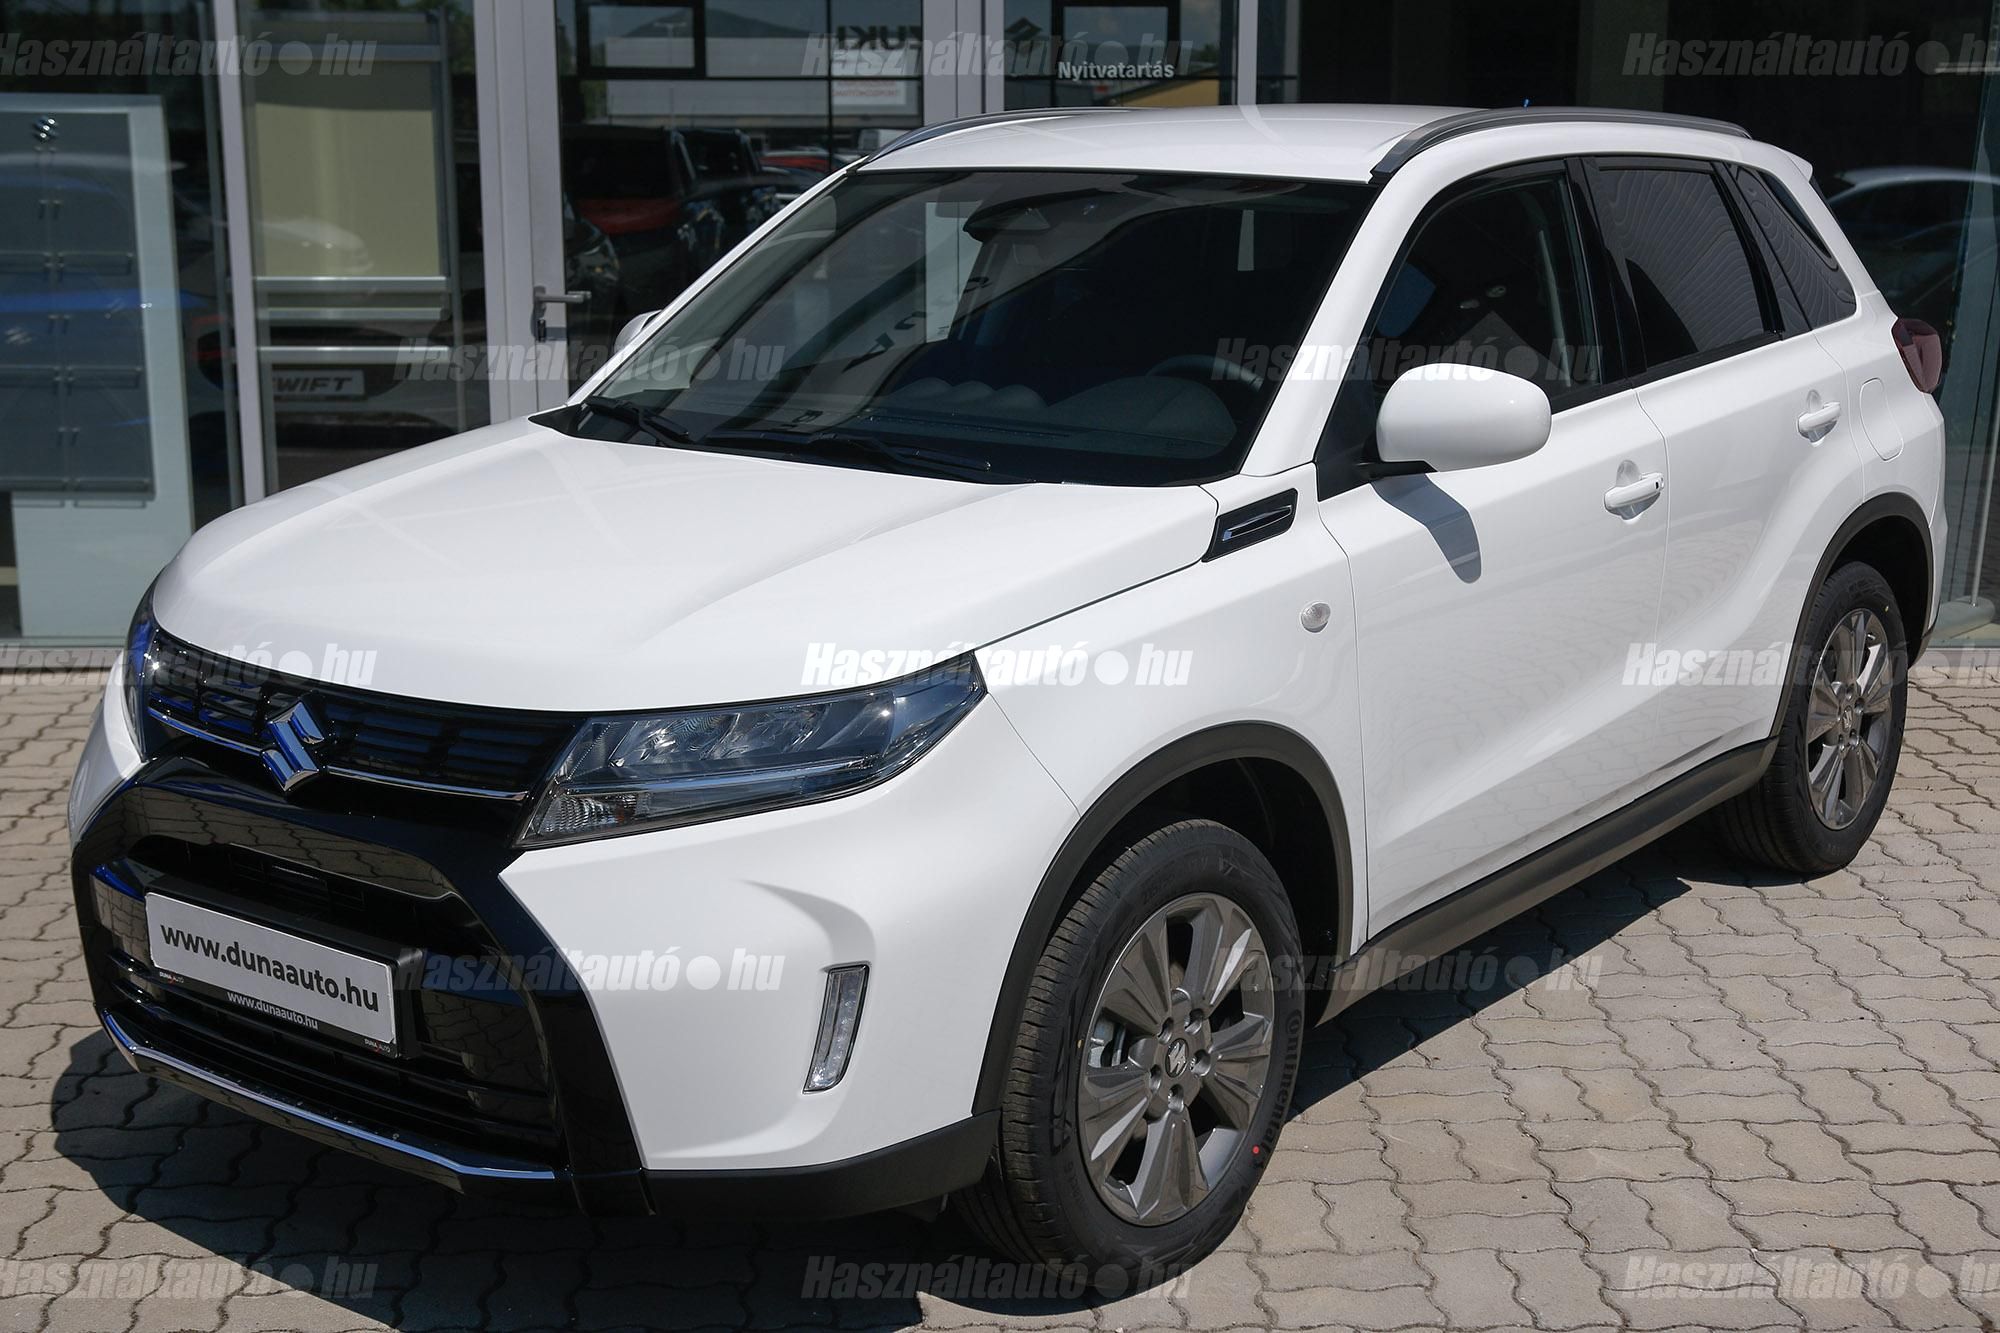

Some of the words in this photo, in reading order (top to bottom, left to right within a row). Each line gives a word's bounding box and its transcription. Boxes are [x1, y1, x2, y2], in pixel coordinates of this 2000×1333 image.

[1058, 61, 1175, 82] Nyitvatartás
[273, 376, 352, 392] WIFT
[160, 924, 379, 1012] www.dunaauto.hu
[227, 992, 319, 1031] www.dunaauto.hu
